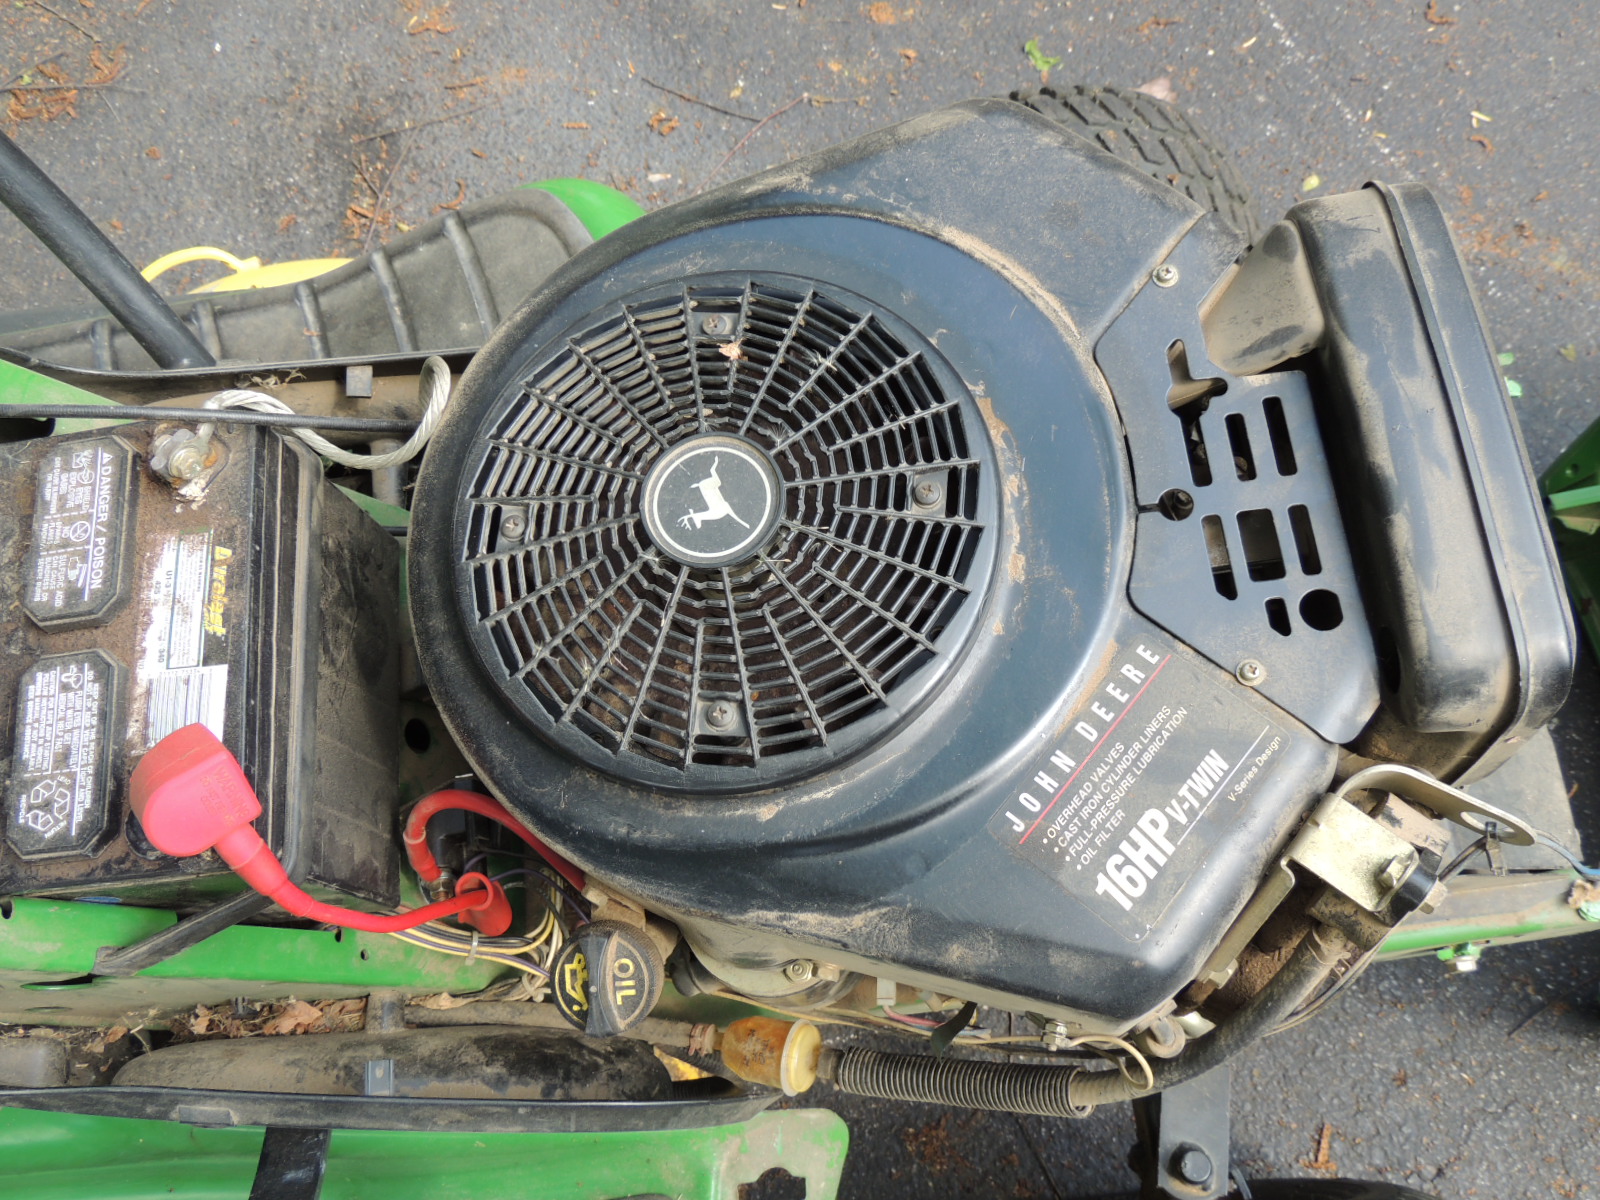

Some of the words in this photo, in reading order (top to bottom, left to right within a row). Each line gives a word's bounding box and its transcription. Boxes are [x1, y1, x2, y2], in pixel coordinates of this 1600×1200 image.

[66, 472, 77, 508] EXPLOSIVE
[75, 487, 83, 504] EYES
[97, 466, 112, 522] DANGER
[62, 526, 70, 538] NO
[36, 558, 44, 580] SEVERE
[42, 557, 52, 590] BLINDNESS
[57, 555, 67, 588] SULFURIC
[90, 537, 106, 589] POISON
[49, 570, 57, 589] CAUSE
[165, 570, 173, 588] U1-3
[41, 592, 48, 601] OR
[55, 591, 64, 607] ACID
[157, 648, 166, 663] 340
[88, 670, 94, 680] DO
[58, 693, 67, 720] MEDICAL
[67, 692, 75, 707] WITH
[75, 691, 83, 710] FLUSH
[26, 701, 34, 724] SERVICE
[38, 697, 47, 737] INSTRUCTIONS
[46, 710, 54, 724] SAFE
[74, 712, 82, 727] EYES
[91, 717, 97, 725] OF
[56, 721, 65, 736] HELP
[63, 733, 72, 744] GET
[1005, 750, 1076, 832] JOHN
[1074, 644, 1160, 742] DEERE
[54, 738, 63, 752] FAST
[70, 729, 81, 769] IMMEDIATELY
[87, 742, 95, 764] REACH
[42, 743, 51, 770] STARTING
[57, 775, 71, 785] LEAD
[79, 768, 87, 785] TIGHT
[87, 765, 93, 774] OF
[1058, 817, 1082, 847] CAST
[1081, 791, 1103, 820] IRON
[1101, 741, 1142, 793] CYLINDER
[1140, 705, 1171, 743] LINERS
[1227, 766, 1258, 802] V-Series
[1255, 736, 1281, 767] Design
[84, 776, 92, 808] CHILDREN
[1047, 782, 1093, 839] OVERHEAD
[1090, 742, 1125, 783] VALVES
[1069, 774, 1136, 857] FULL-PRESSURE
[1132, 706, 1188, 775] LUBRICATION
[19, 794, 27, 823] RECYCLE
[75, 804, 84, 823] LEVEL
[44, 820, 67, 839] RETURN
[1081, 843, 1098, 865] OIL
[1094, 809, 1126, 848] FILTER
[1095, 808, 1176, 911] 16HP
[1164, 749, 1230, 826] V-TWIN
[613, 958, 637, 1005] OIL
